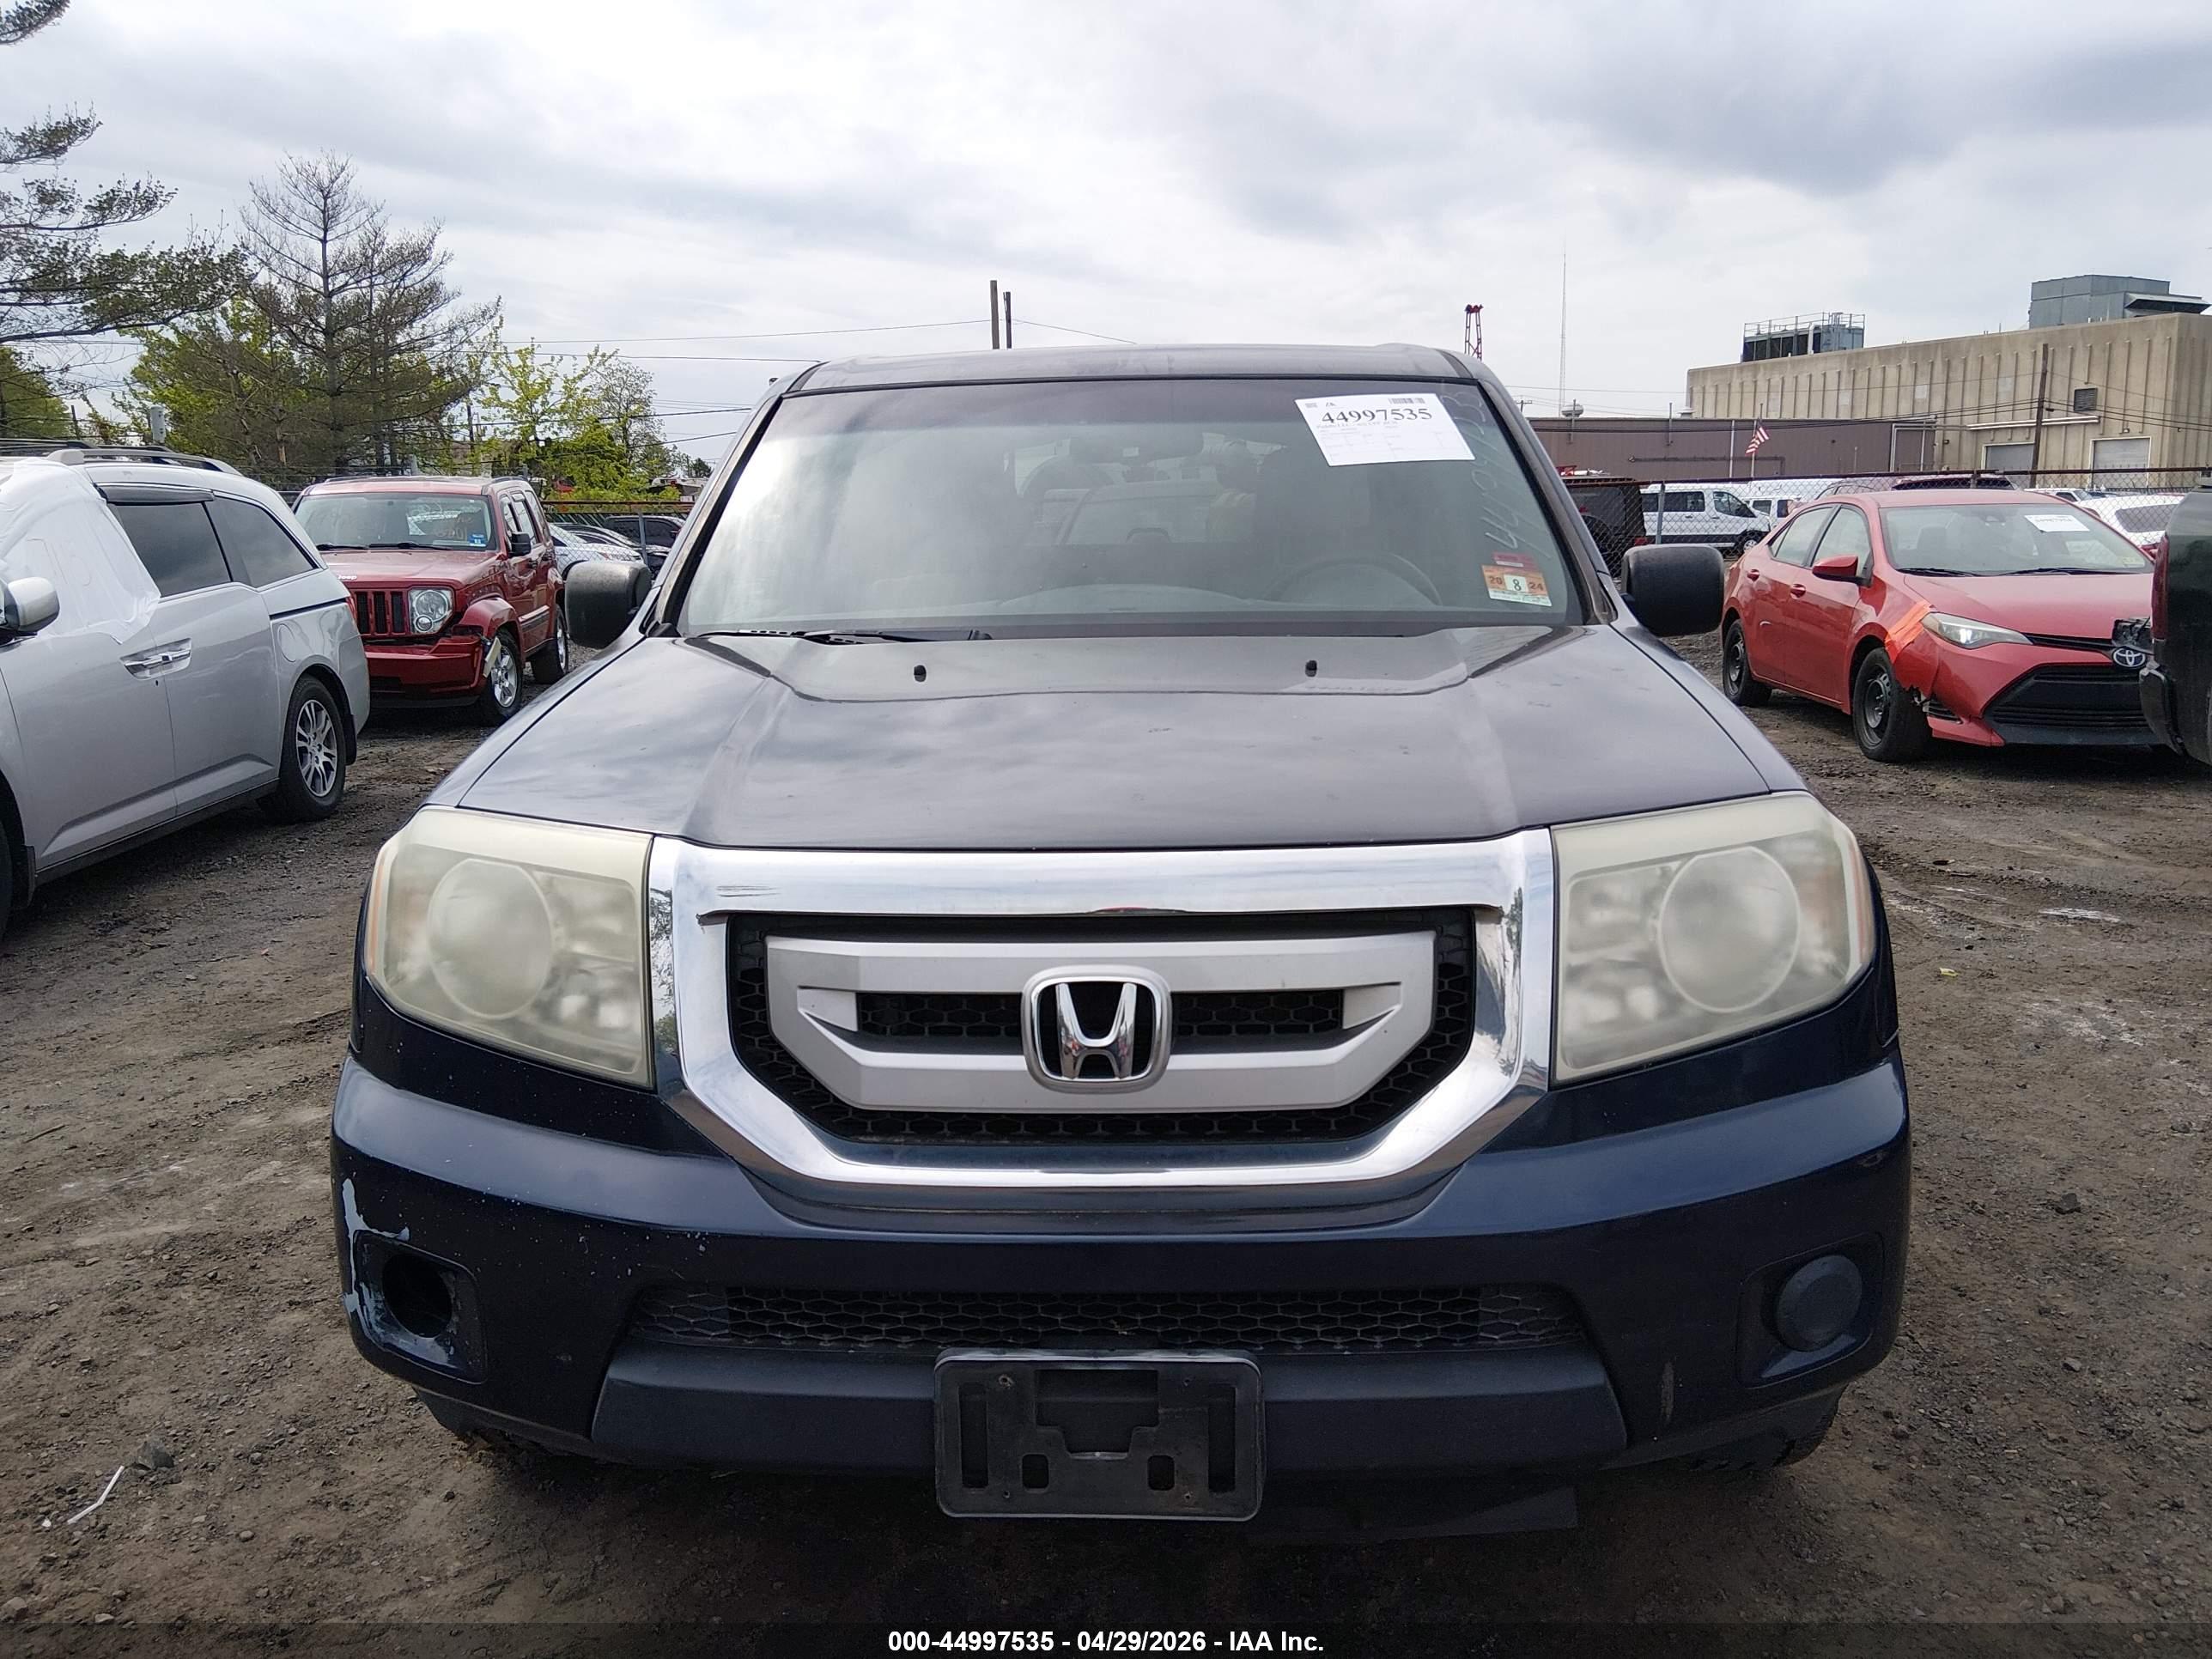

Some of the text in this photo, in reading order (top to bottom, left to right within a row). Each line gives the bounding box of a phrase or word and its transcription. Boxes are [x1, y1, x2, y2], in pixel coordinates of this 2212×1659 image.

[1321, 407, 1432, 423] 44997535
[1488, 575, 1544, 592] 20 8 24
